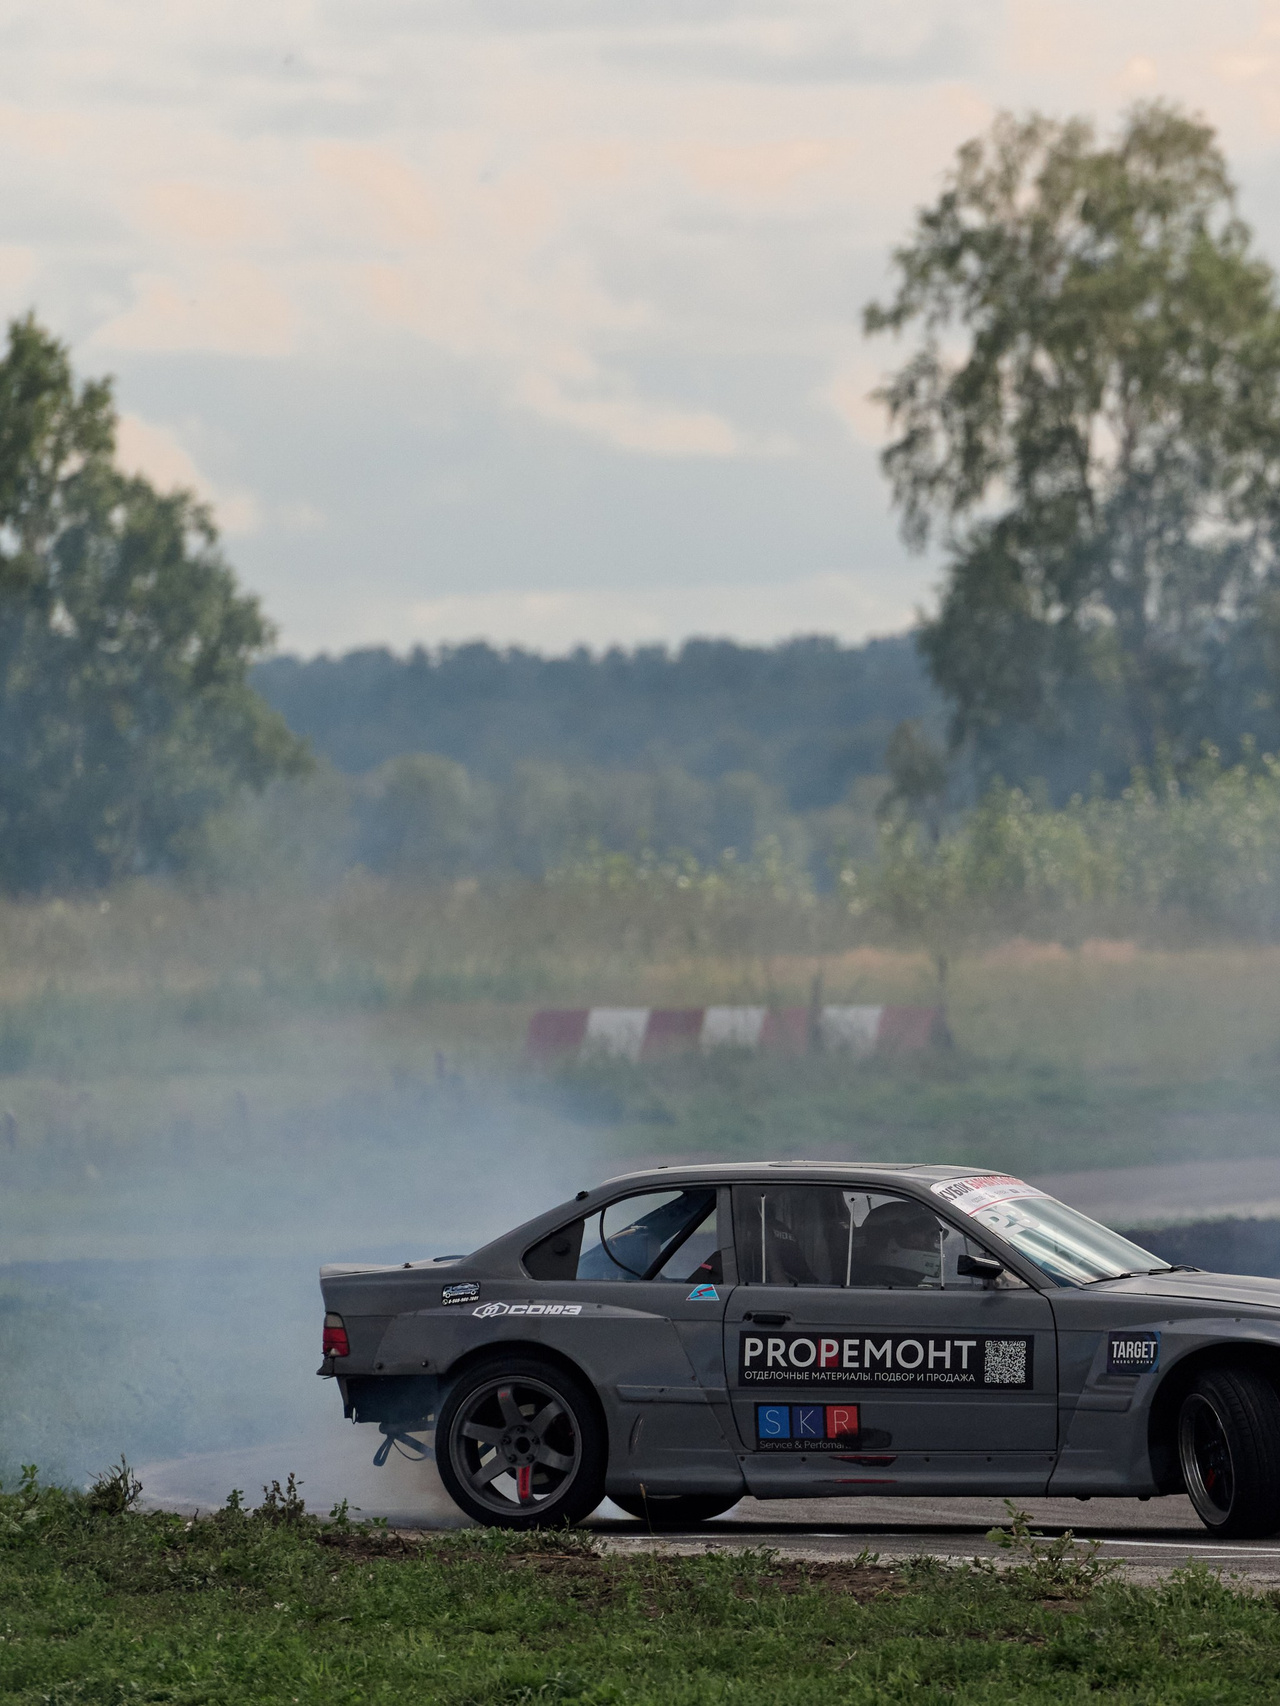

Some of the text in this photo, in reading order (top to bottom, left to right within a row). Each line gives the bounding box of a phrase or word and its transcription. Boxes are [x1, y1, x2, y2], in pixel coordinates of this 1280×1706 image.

[938, 1181, 974, 1202] КУБОК
[507, 1305, 582, 1315] СОЮЗ
[1112, 1341, 1157, 1358] TARGET
[744, 1371, 976, 1383] ОТДЕЛОЧНЫЕ МАТЕРИАЛЫ. ПОДБОР И ПРОДАЖА
[760, 1440, 792, 1449] Service
[794, 1440, 801, 1449] &
